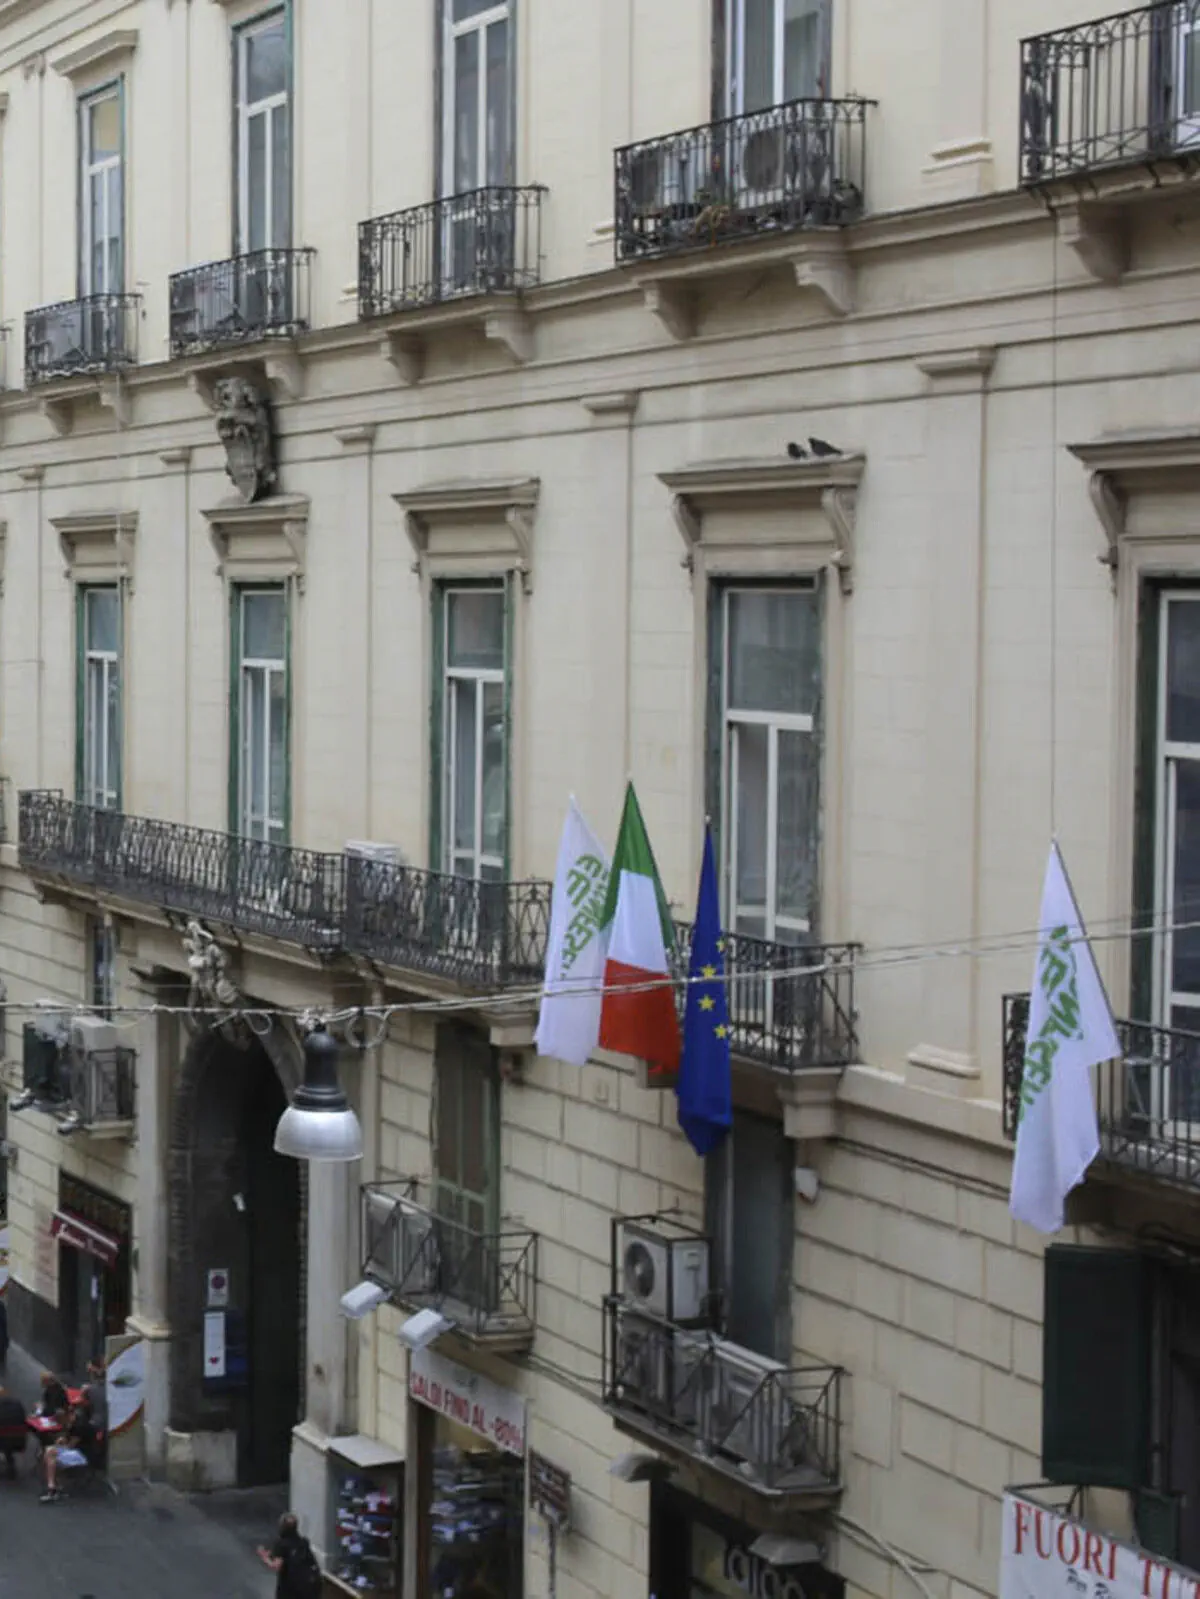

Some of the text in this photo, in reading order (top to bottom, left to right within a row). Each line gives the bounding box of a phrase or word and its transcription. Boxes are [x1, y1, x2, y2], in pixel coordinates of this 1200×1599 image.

[411, 1371, 443, 1407] SALDI
[444, 1388, 470, 1424] FINO
[471, 1403, 488, 1434] AL
[1014, 1501, 1118, 1581] FUORI
